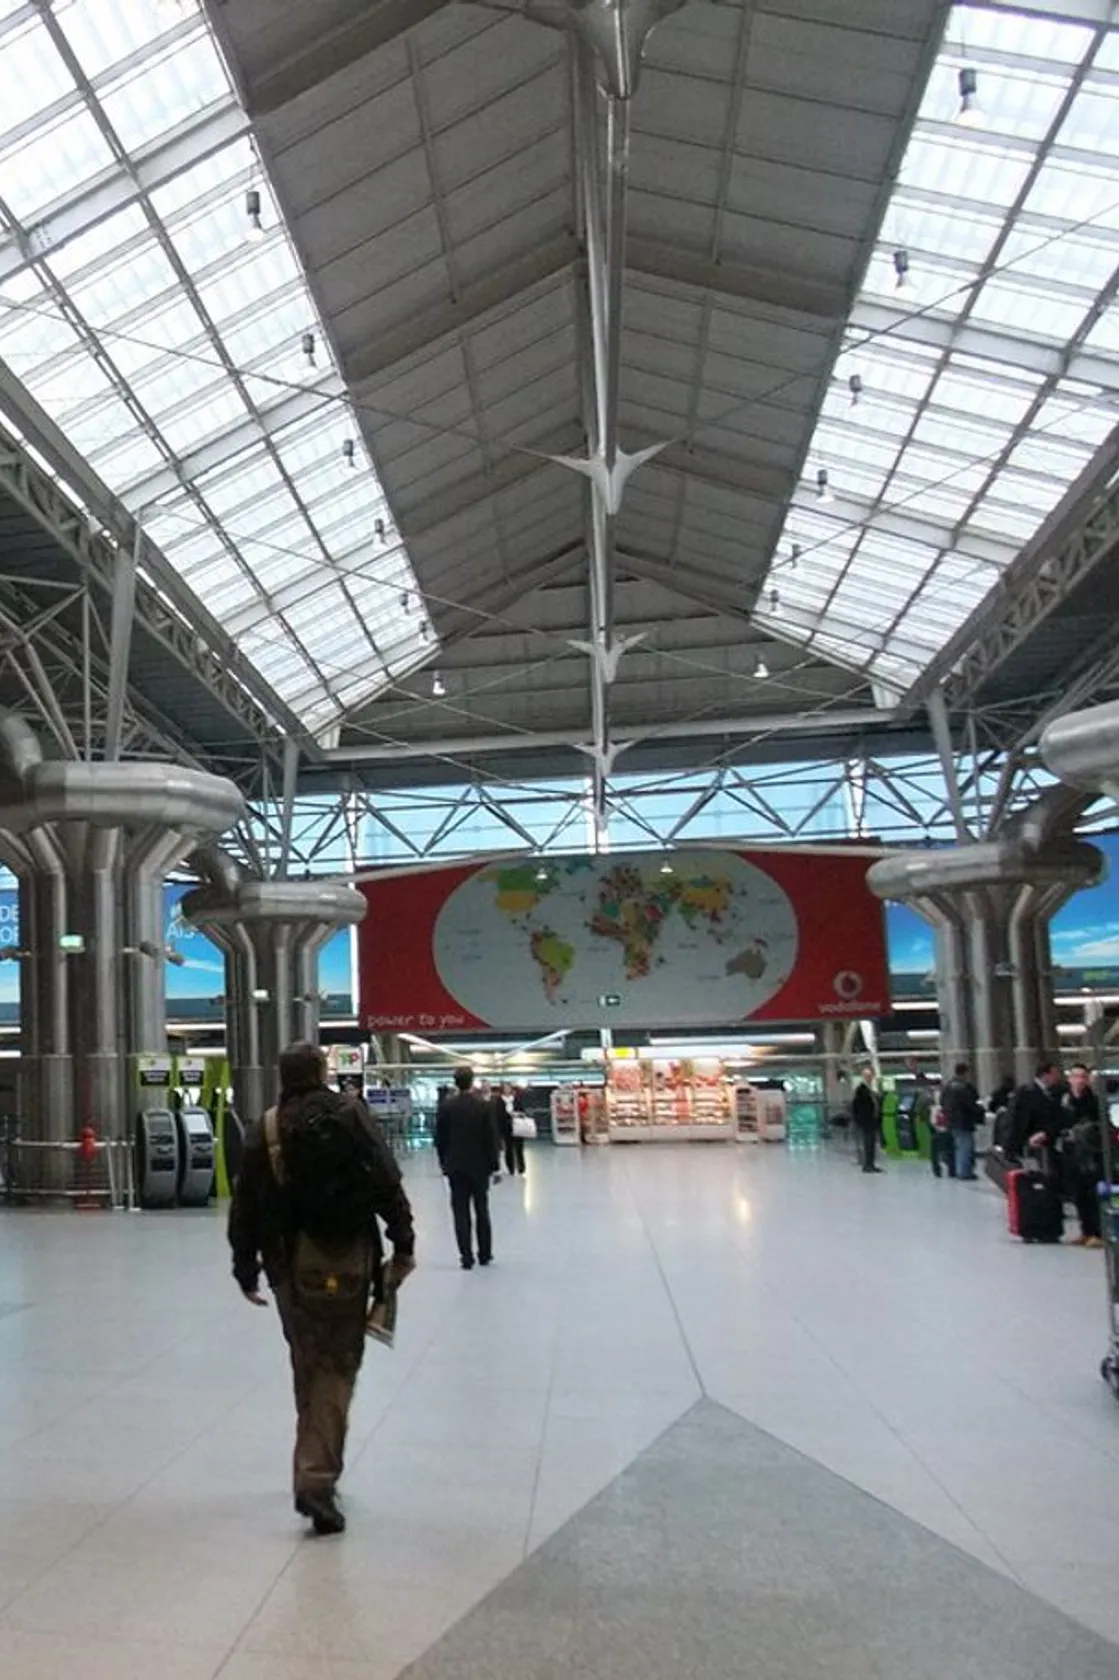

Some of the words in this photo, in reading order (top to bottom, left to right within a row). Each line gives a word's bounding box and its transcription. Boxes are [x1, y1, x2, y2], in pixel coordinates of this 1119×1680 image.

[367, 1014, 414, 1028] power
[419, 1012, 436, 1026] to
[440, 1013, 465, 1030] you
